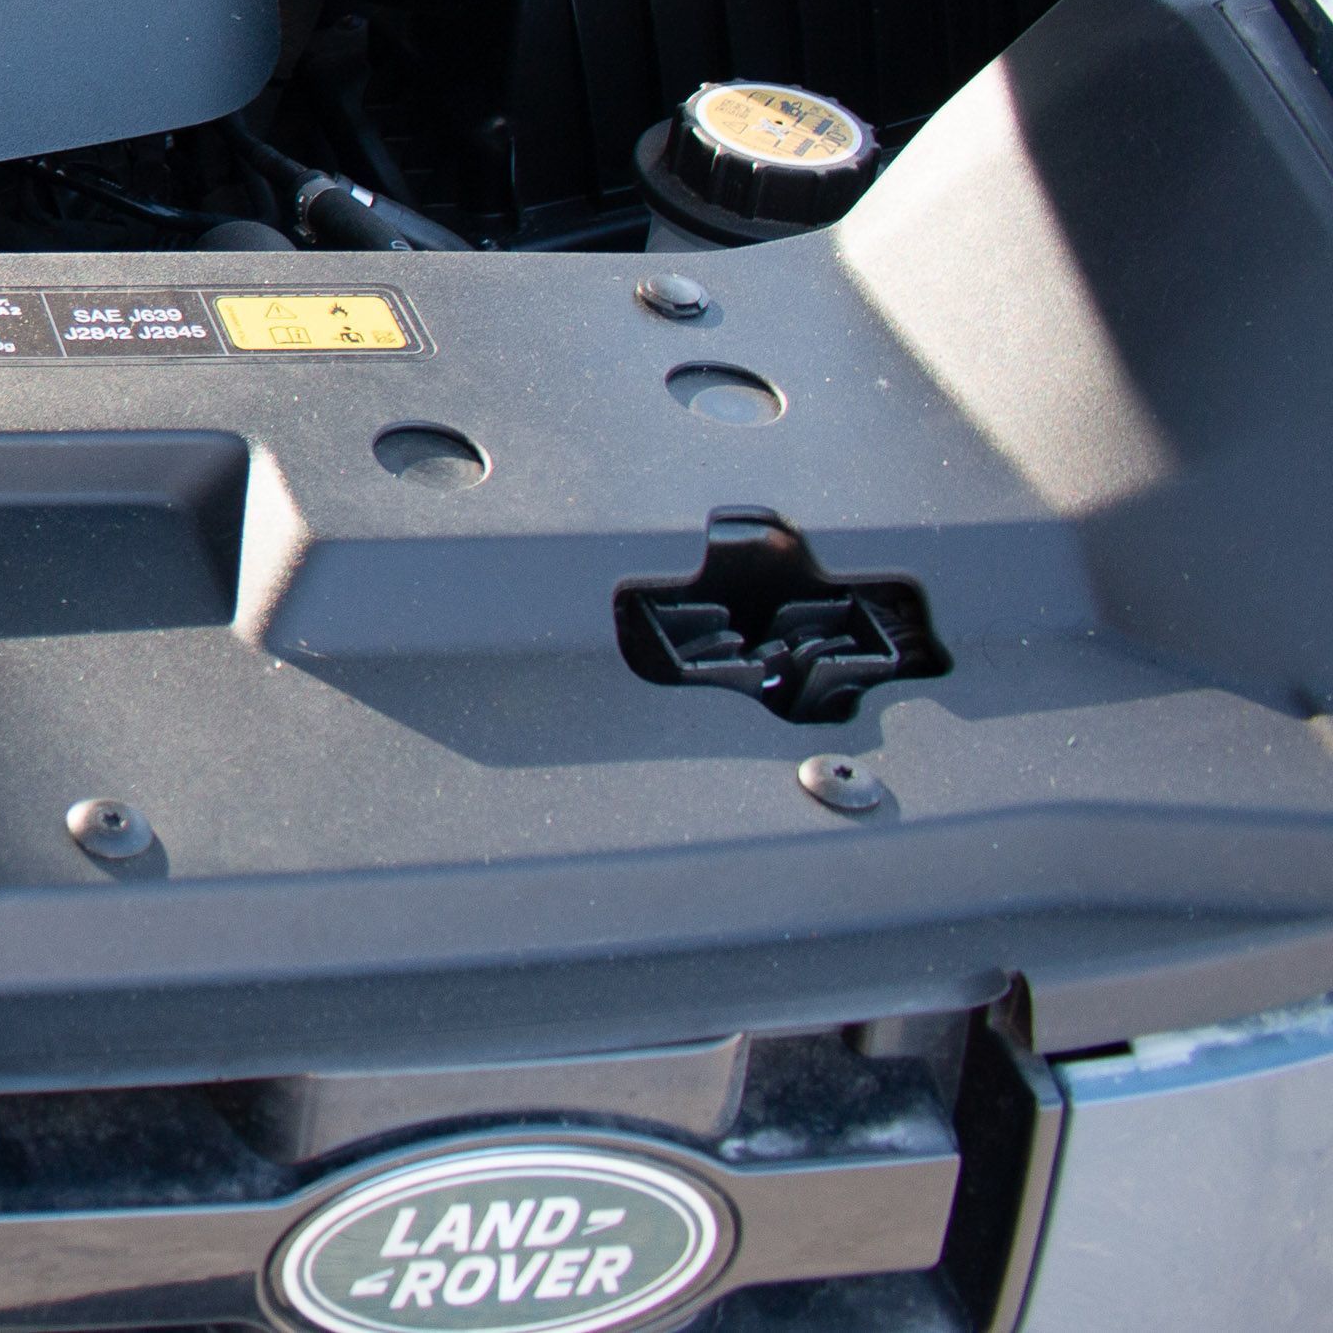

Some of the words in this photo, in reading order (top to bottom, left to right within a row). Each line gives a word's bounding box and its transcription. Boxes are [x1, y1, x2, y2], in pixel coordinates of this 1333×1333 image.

[64, 326, 133, 340] J2842
[139, 325, 207, 339] J2845
[73, 309, 125, 323] SAE
[128, 308, 183, 323] J639
[380, 1196, 581, 1258] LAND
[389, 1245, 633, 1309] ROVER
